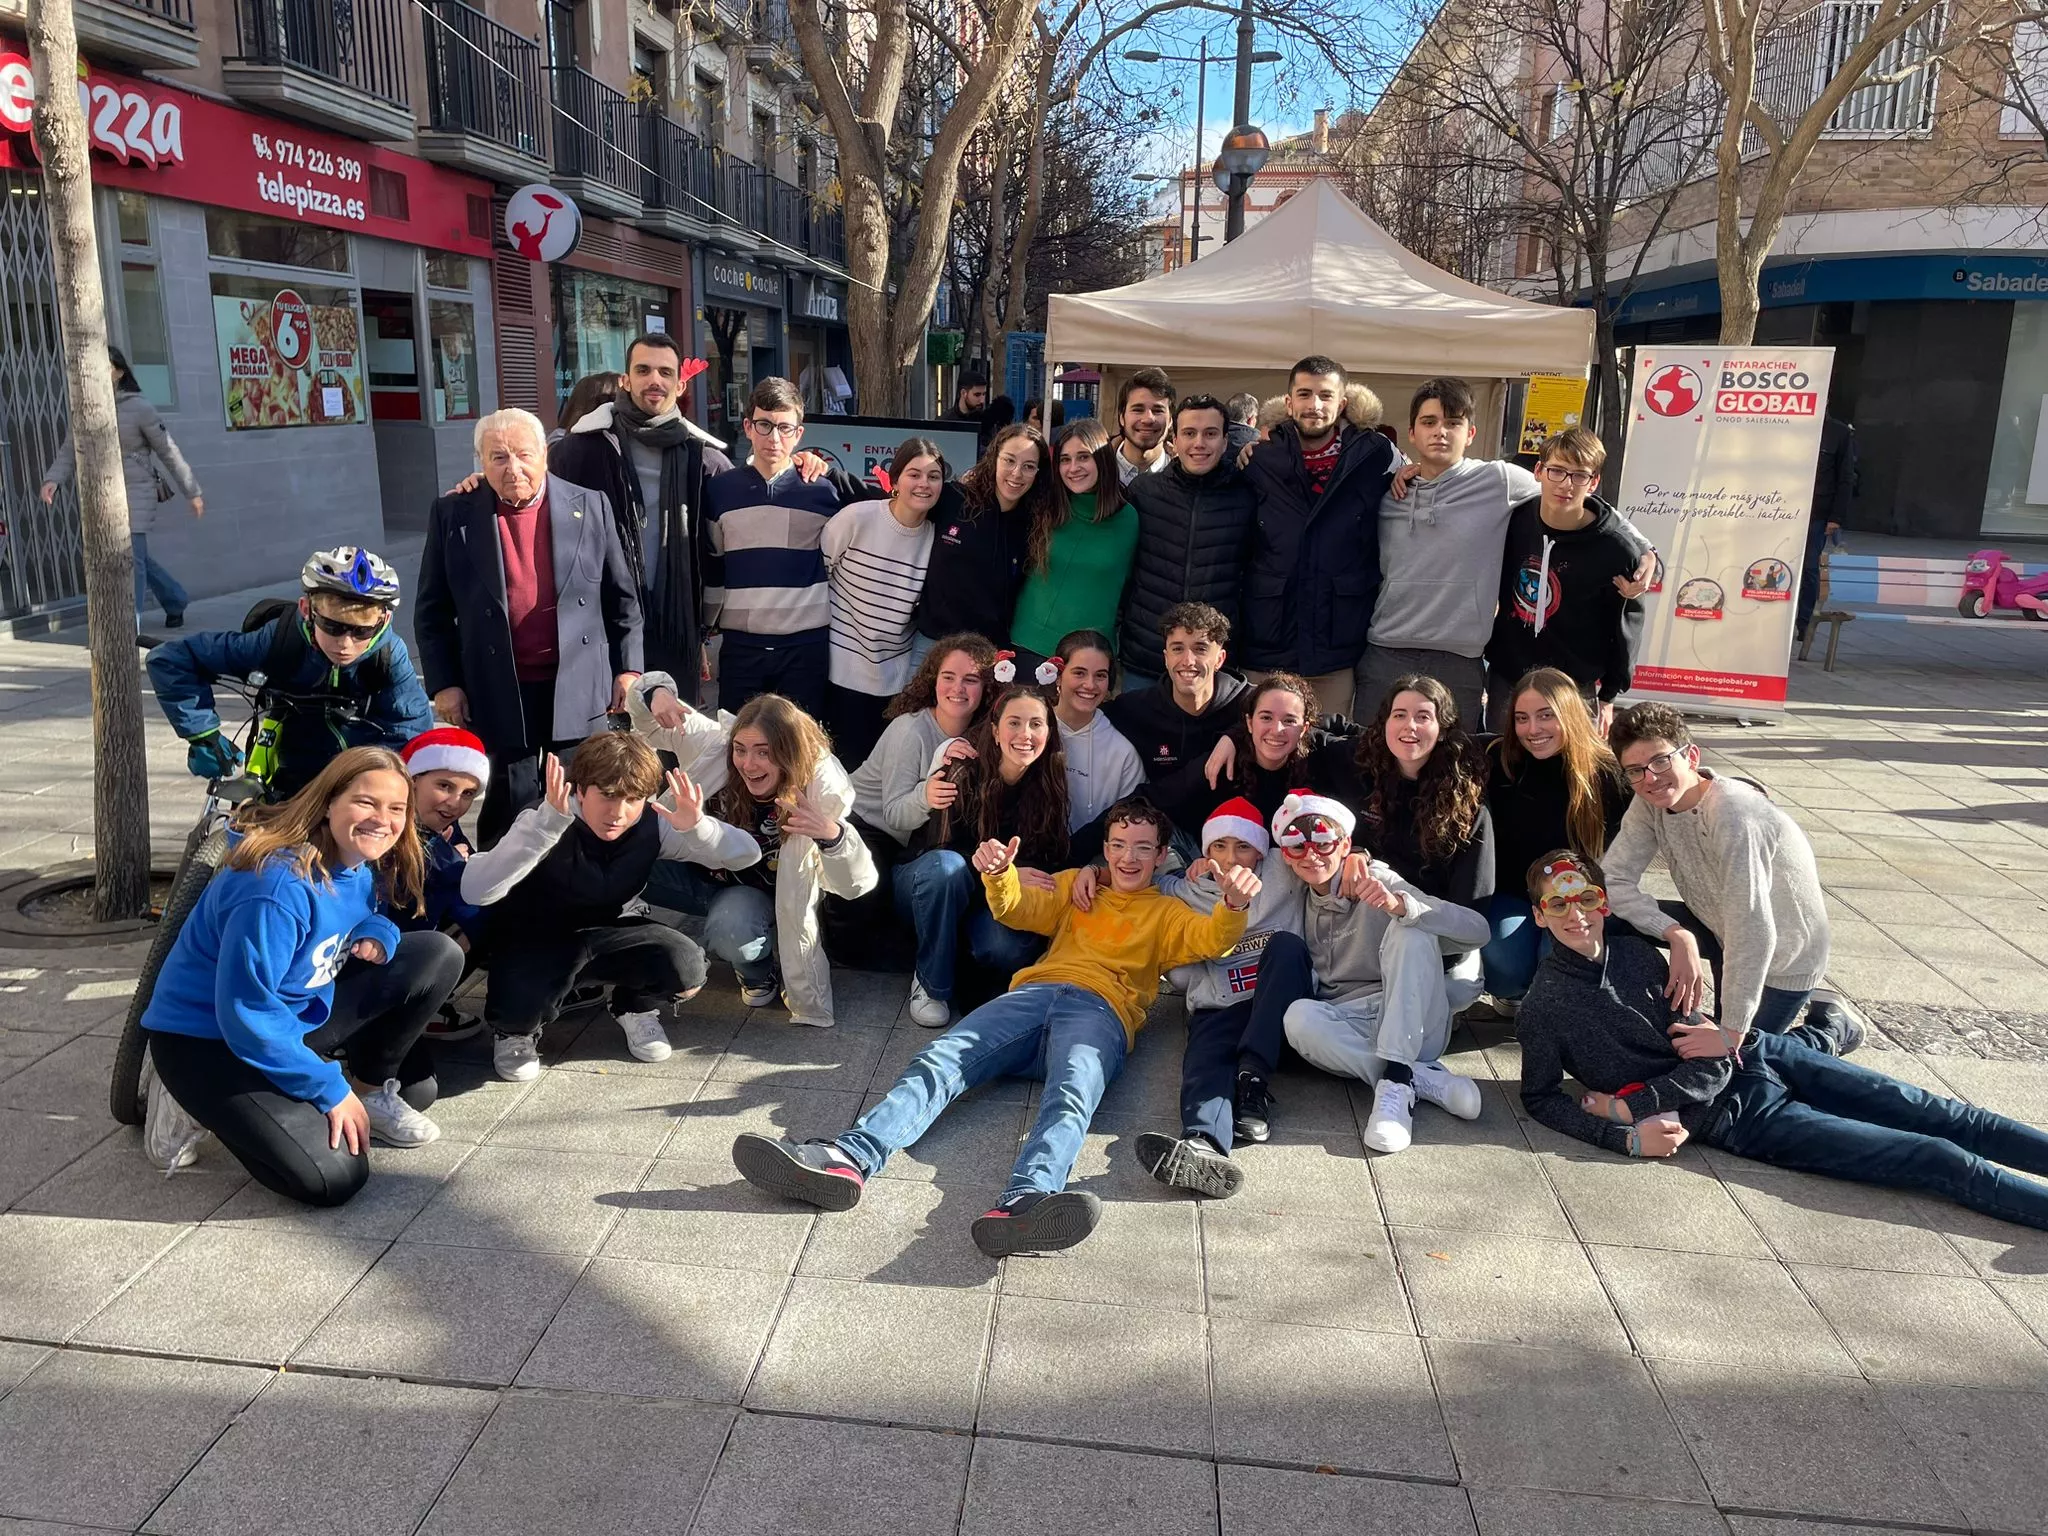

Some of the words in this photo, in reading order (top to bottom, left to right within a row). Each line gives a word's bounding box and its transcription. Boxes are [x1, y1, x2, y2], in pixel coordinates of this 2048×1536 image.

[276, 139, 304, 168] 974
[308, 148, 334, 176] 226
[337, 156, 361, 183] 399
[257, 171, 365, 220] telepizza.es
[277, 312, 299, 359] 6
[230, 347, 268, 365] MEGA
[1723, 360, 1797, 370] ENTARACHEN
[231, 364, 269, 376] MEDIANA
[1721, 371, 1809, 390] BOSCO
[1718, 393, 1812, 413] GLOBAL
[1746, 417, 1790, 425] SALESIANA
[1643, 484, 1669, 498] Por
[1673, 491, 1686, 500] un
[1689, 487, 1726, 501] mundo
[1625, 500, 1680, 520] equitativo
[1679, 510, 1688, 522] y
[1639, 670, 1682, 680] información
[1695, 675, 1758, 687] boscoglobal.org
